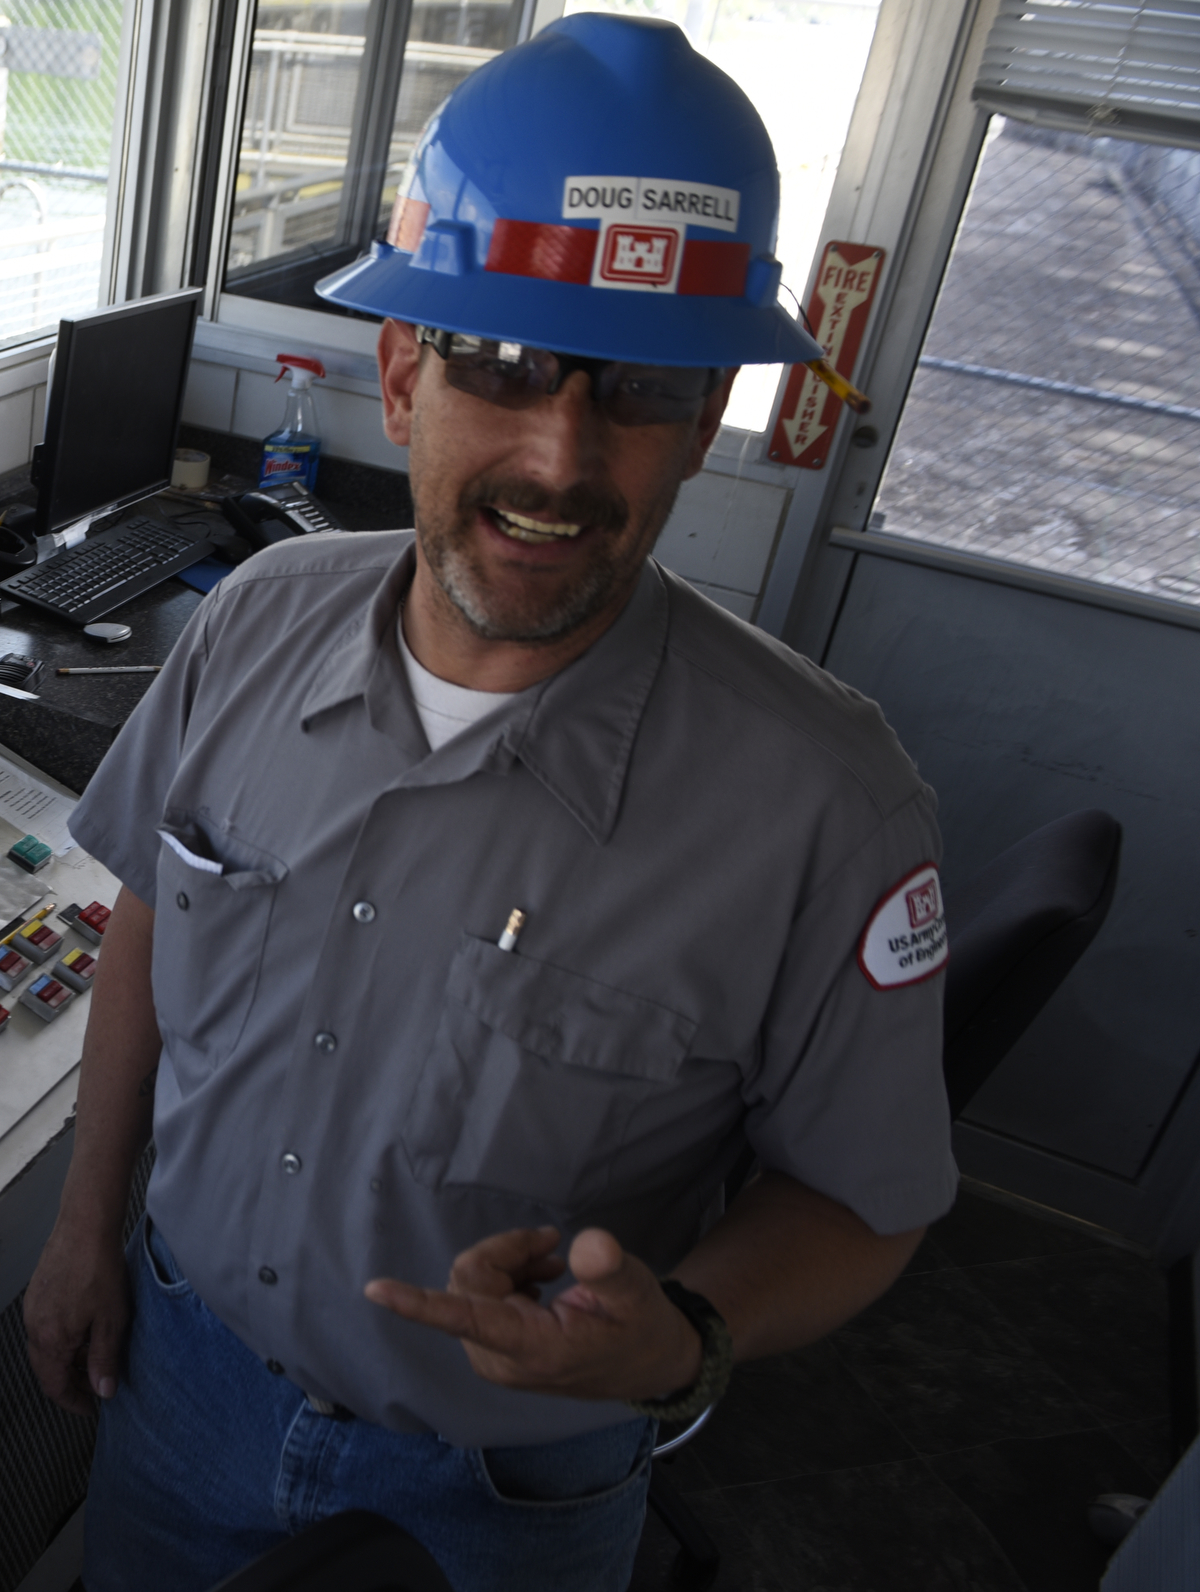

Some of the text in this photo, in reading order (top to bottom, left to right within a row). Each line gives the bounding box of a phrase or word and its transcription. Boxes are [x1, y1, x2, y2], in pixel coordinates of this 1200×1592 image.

[568, 186, 736, 223] DOUG SARRELL
[822, 265, 872, 293] FIRE
[794, 291, 849, 447] EXTINUISHER
[264, 458, 303, 477] Windex
[888, 934, 909, 953] US
[910, 924, 939, 948] Army
[898, 951, 914, 968] of
